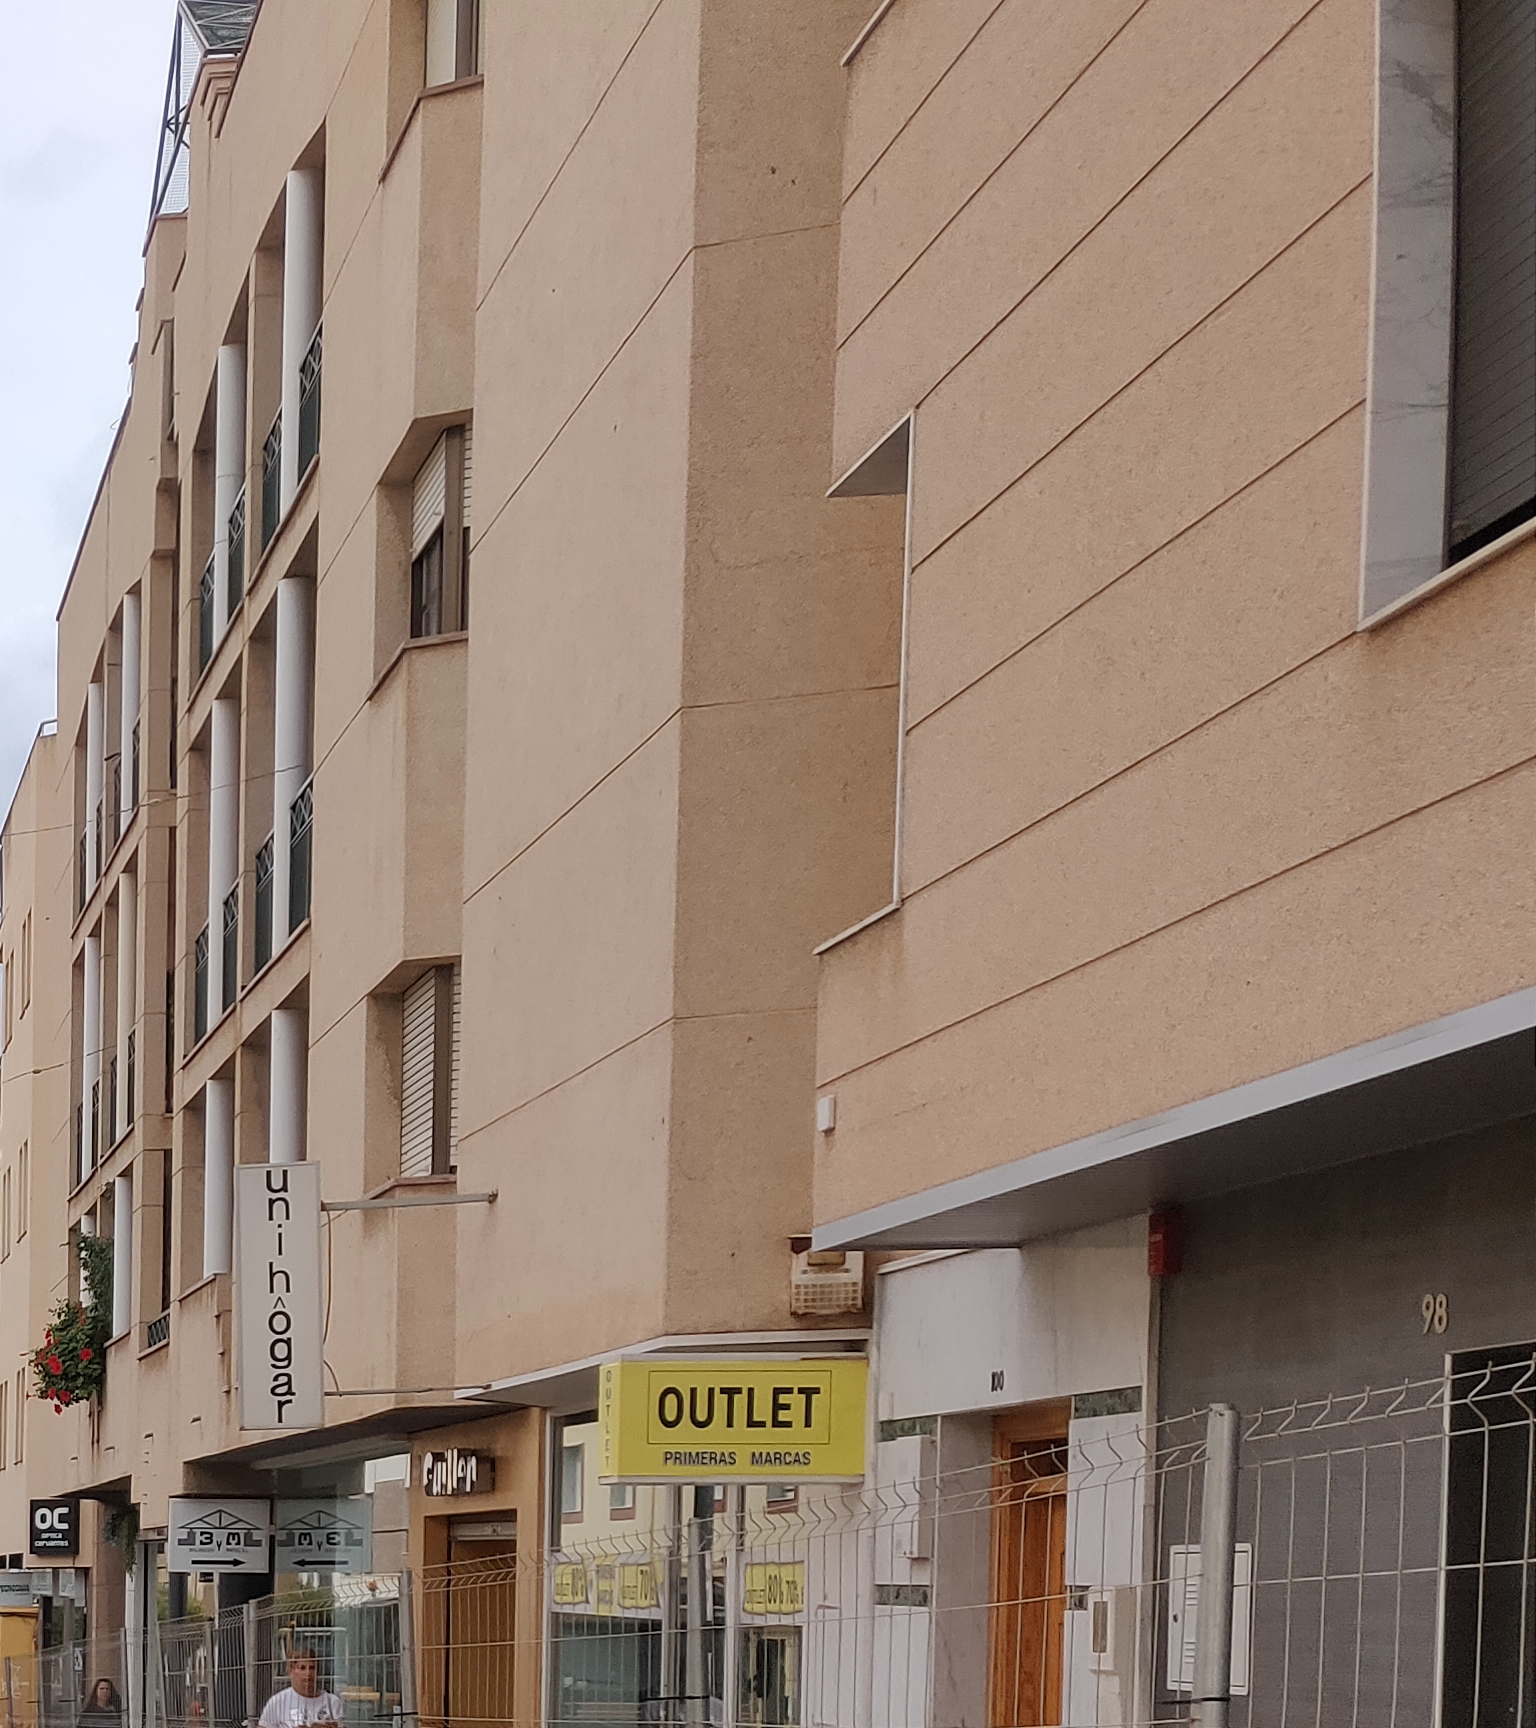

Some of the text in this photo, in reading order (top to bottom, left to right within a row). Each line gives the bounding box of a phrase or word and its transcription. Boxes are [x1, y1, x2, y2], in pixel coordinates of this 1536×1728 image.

[1422, 1293, 1448, 1335] 98
[605, 1369, 613, 1468] OUTLET
[657, 1386, 821, 1429] OUTLET
[663, 1451, 812, 1467] PRIMERAS MARCAS
[35, 1507, 69, 1530] OC
